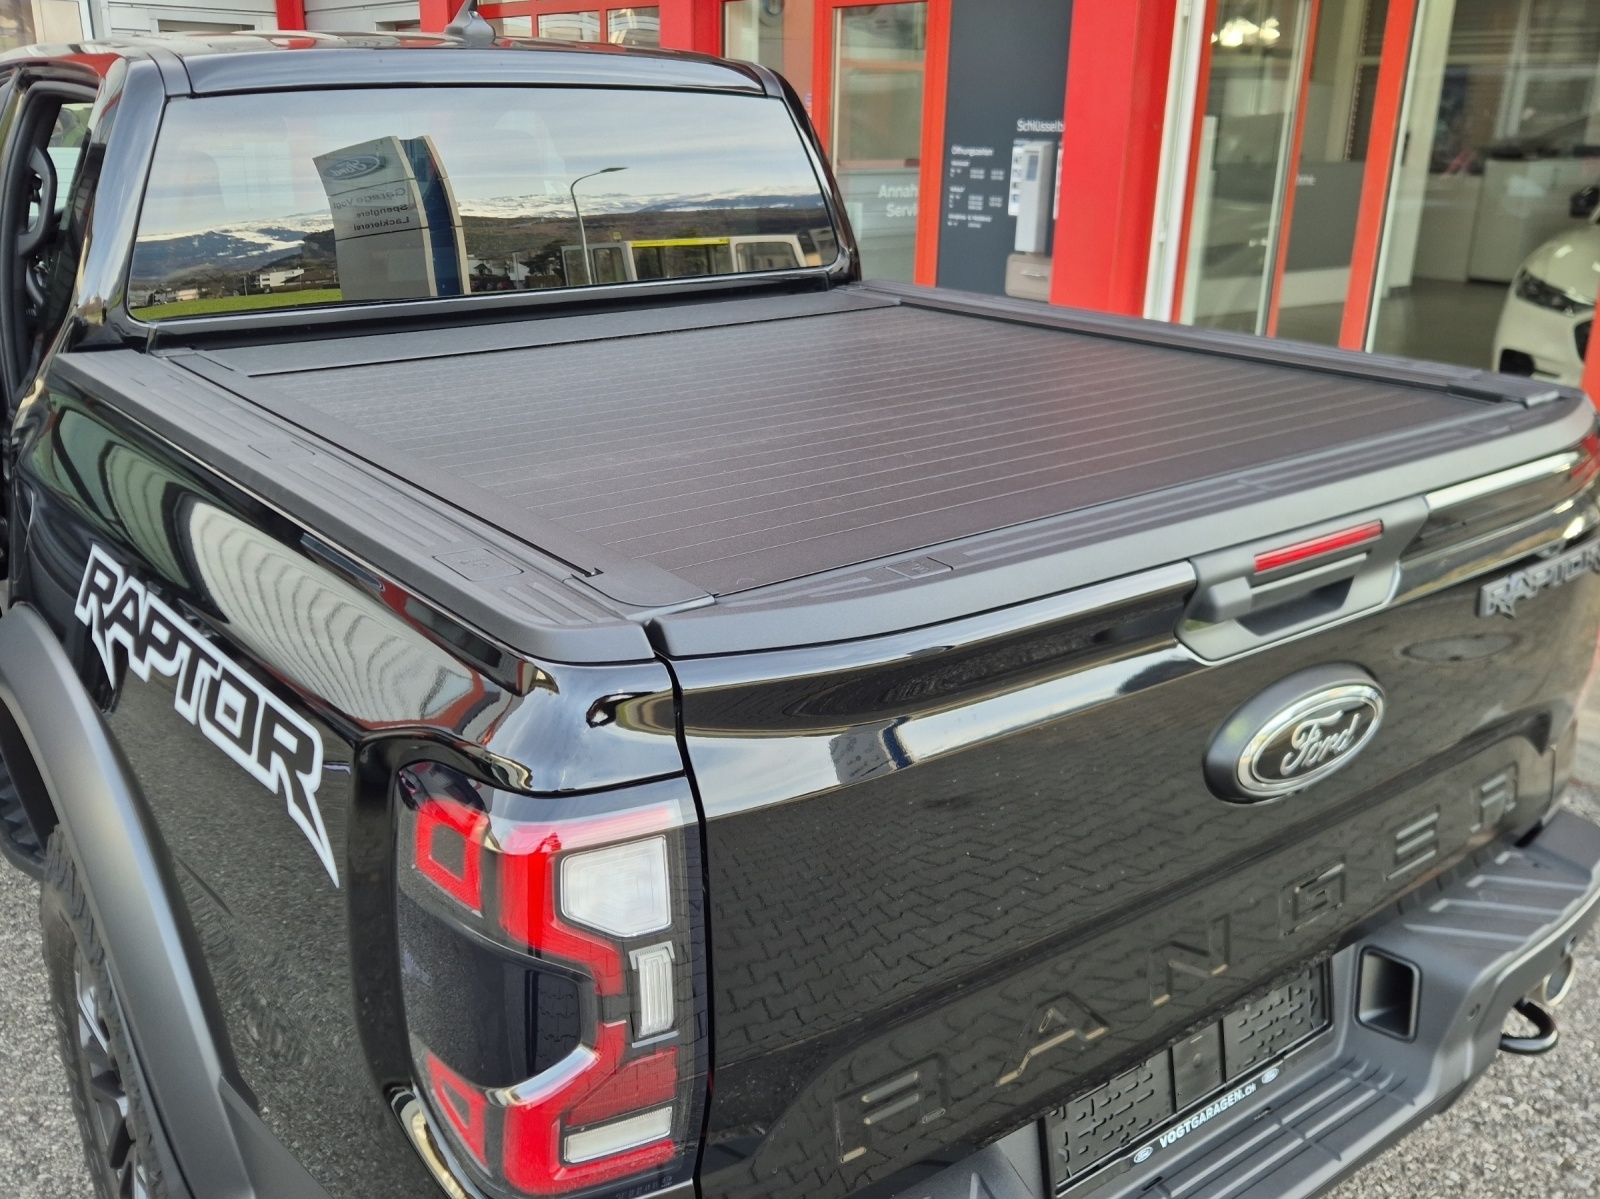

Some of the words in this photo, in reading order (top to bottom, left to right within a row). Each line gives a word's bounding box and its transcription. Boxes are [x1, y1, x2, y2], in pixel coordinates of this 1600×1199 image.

[74, 543, 339, 888] RAPTOR
[1279, 709, 1361, 776] Ford
[838, 762, 1518, 1164] RANGER
